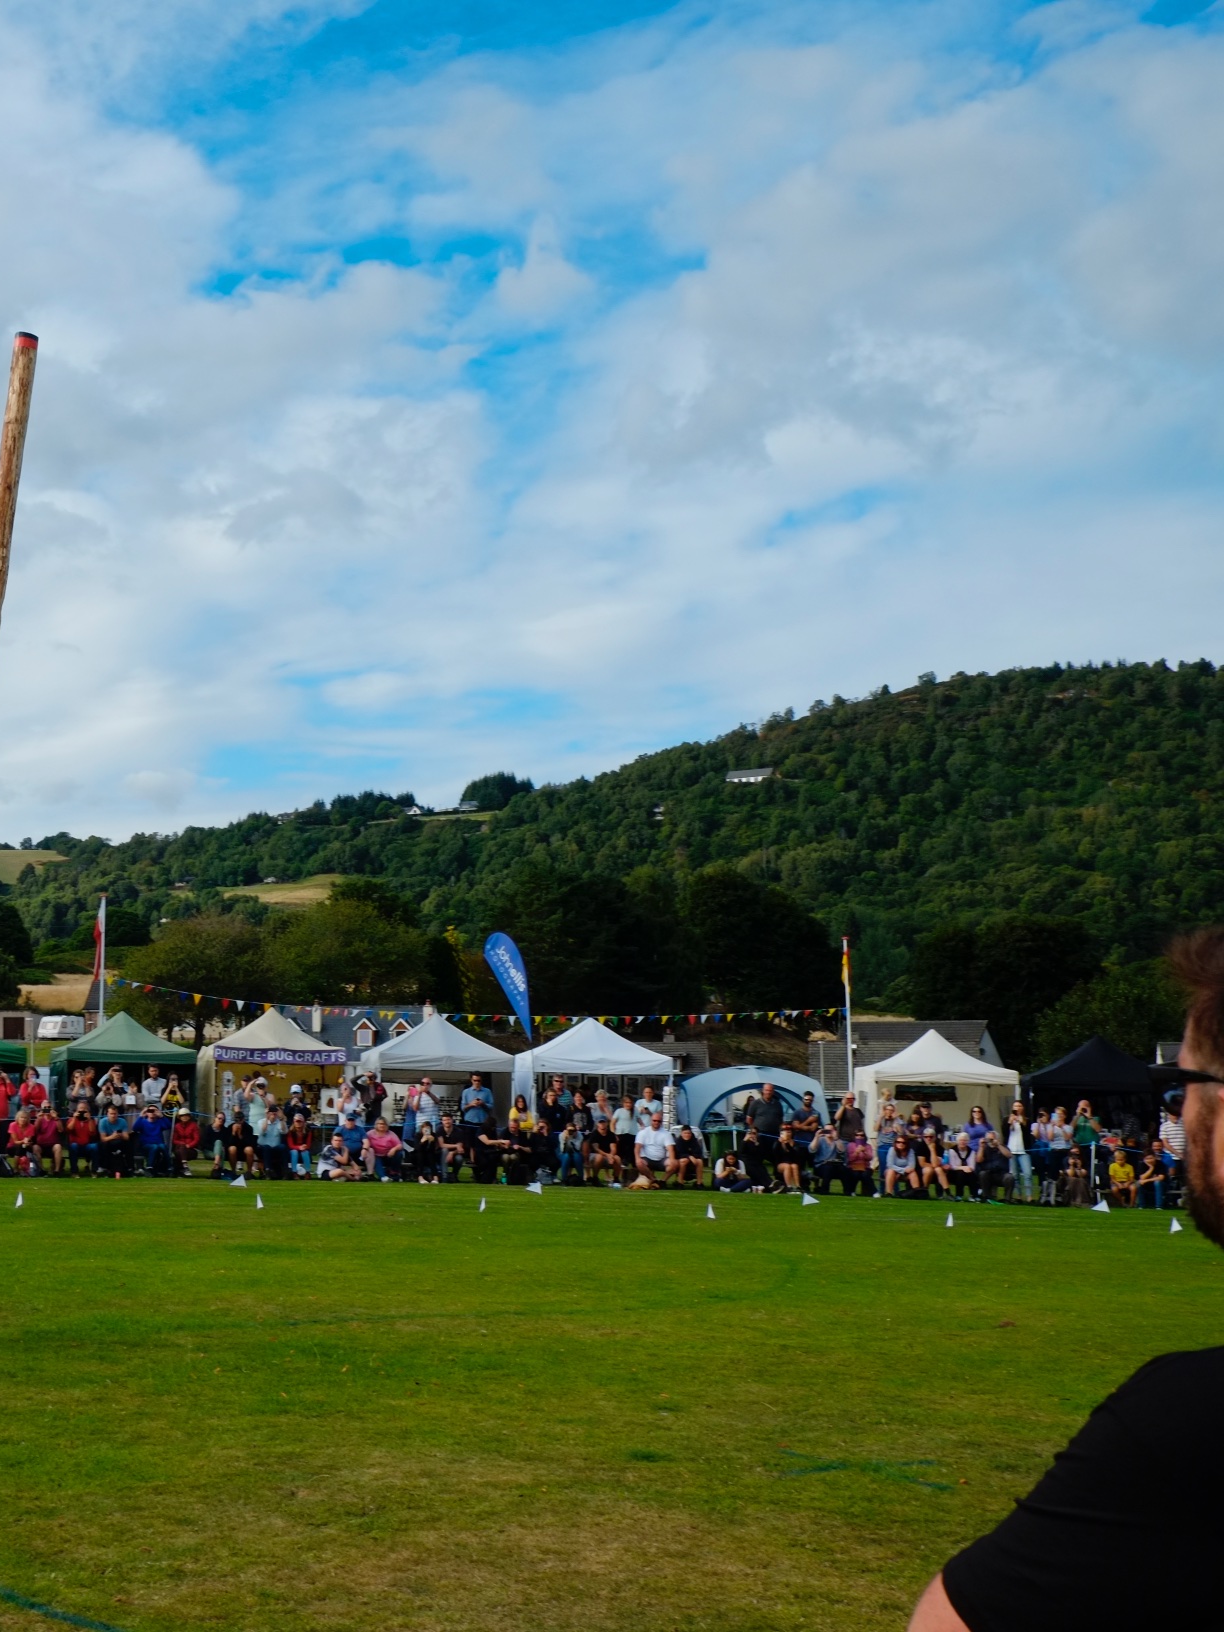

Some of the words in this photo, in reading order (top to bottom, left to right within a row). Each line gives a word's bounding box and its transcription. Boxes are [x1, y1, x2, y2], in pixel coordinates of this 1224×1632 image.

[487, 945, 524, 1005] PHOTOGRAPHY
[215, 1048, 293, 1061] PURPLE-BUG
[295, 1052, 346, 1062] CRAFTS
